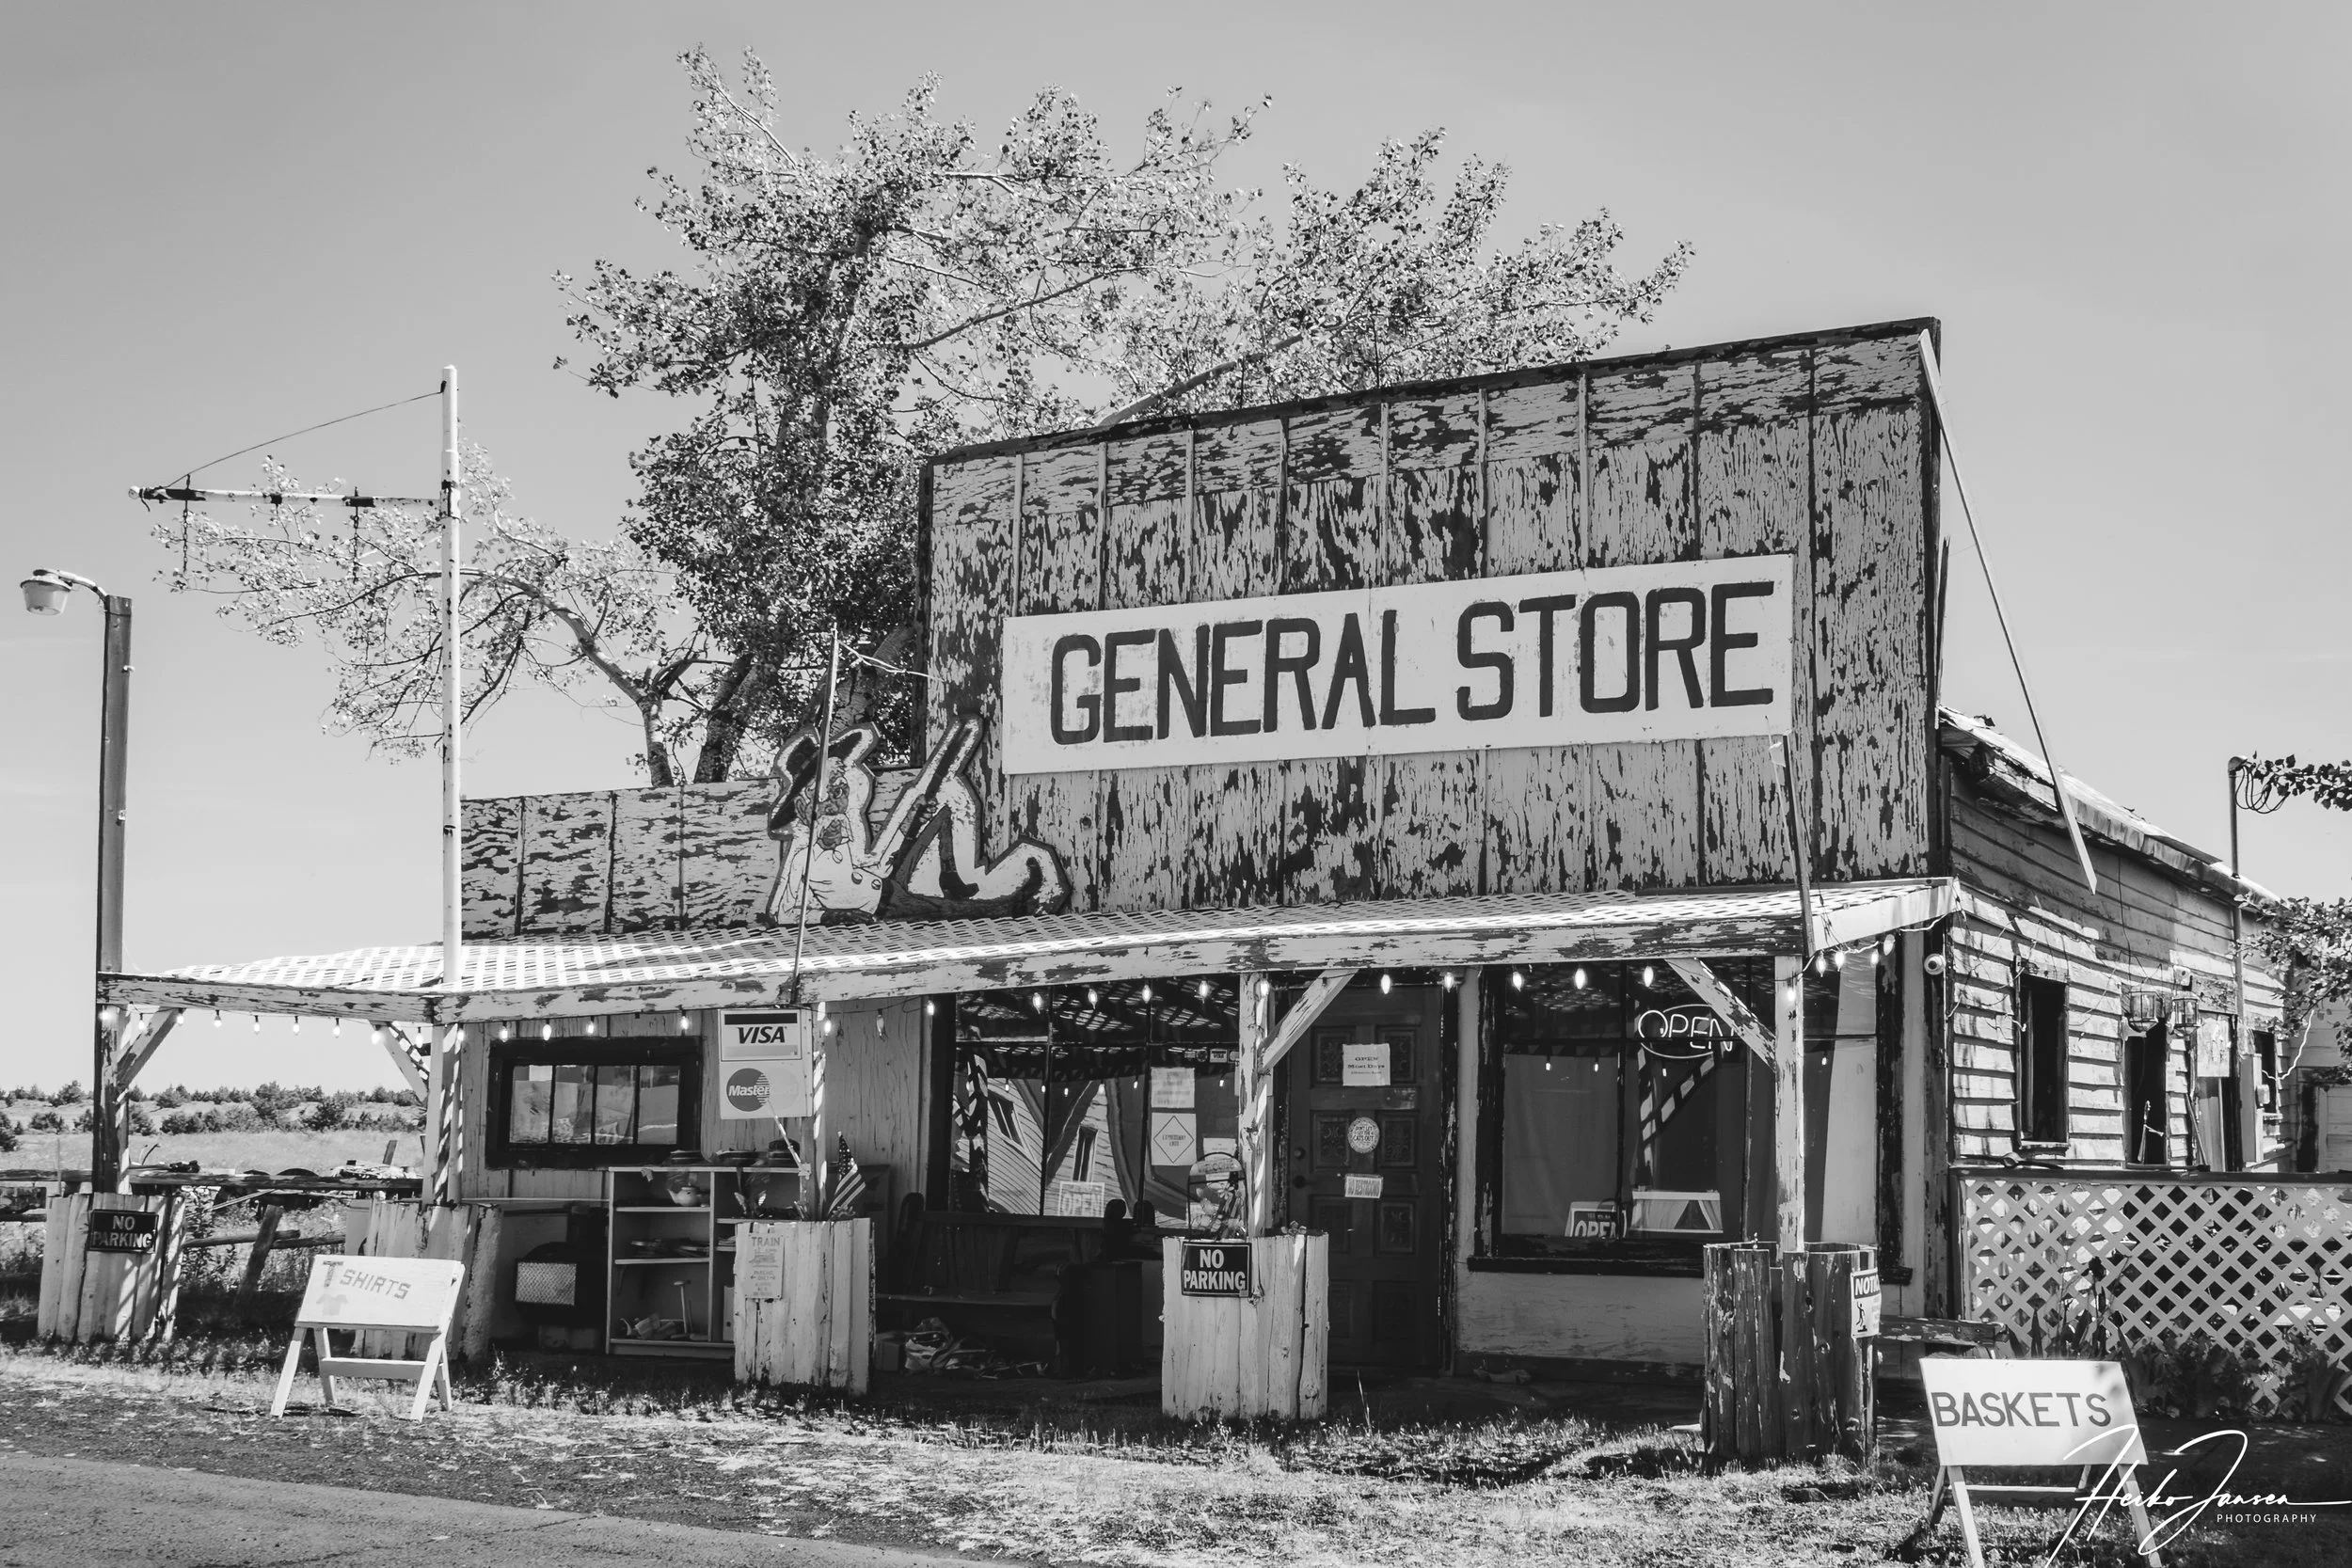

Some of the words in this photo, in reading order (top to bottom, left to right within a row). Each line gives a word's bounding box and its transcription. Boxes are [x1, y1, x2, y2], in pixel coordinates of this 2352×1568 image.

[1050, 608, 1436, 746] GENERAL
[1455, 580, 1774, 721] STORE
[738, 1026, 786, 1044] VISA
[1637, 1009, 1735, 1052] OPEN
[728, 1085, 770, 1097] Master
[1061, 1193, 1101, 1216] OPEN
[113, 1215, 135, 1230] NO
[93, 1231, 152, 1248] PARKING
[752, 1237, 781, 1246] TRAIN
[1200, 1249, 1224, 1269] NO
[323, 1260, 344, 1288] T
[340, 1270, 412, 1300] SHIRTS
[1184, 1270, 1246, 1291] PARKING
[1855, 1275, 1881, 1296] NOTIC
[1931, 1392, 2111, 1427] BASKETS
